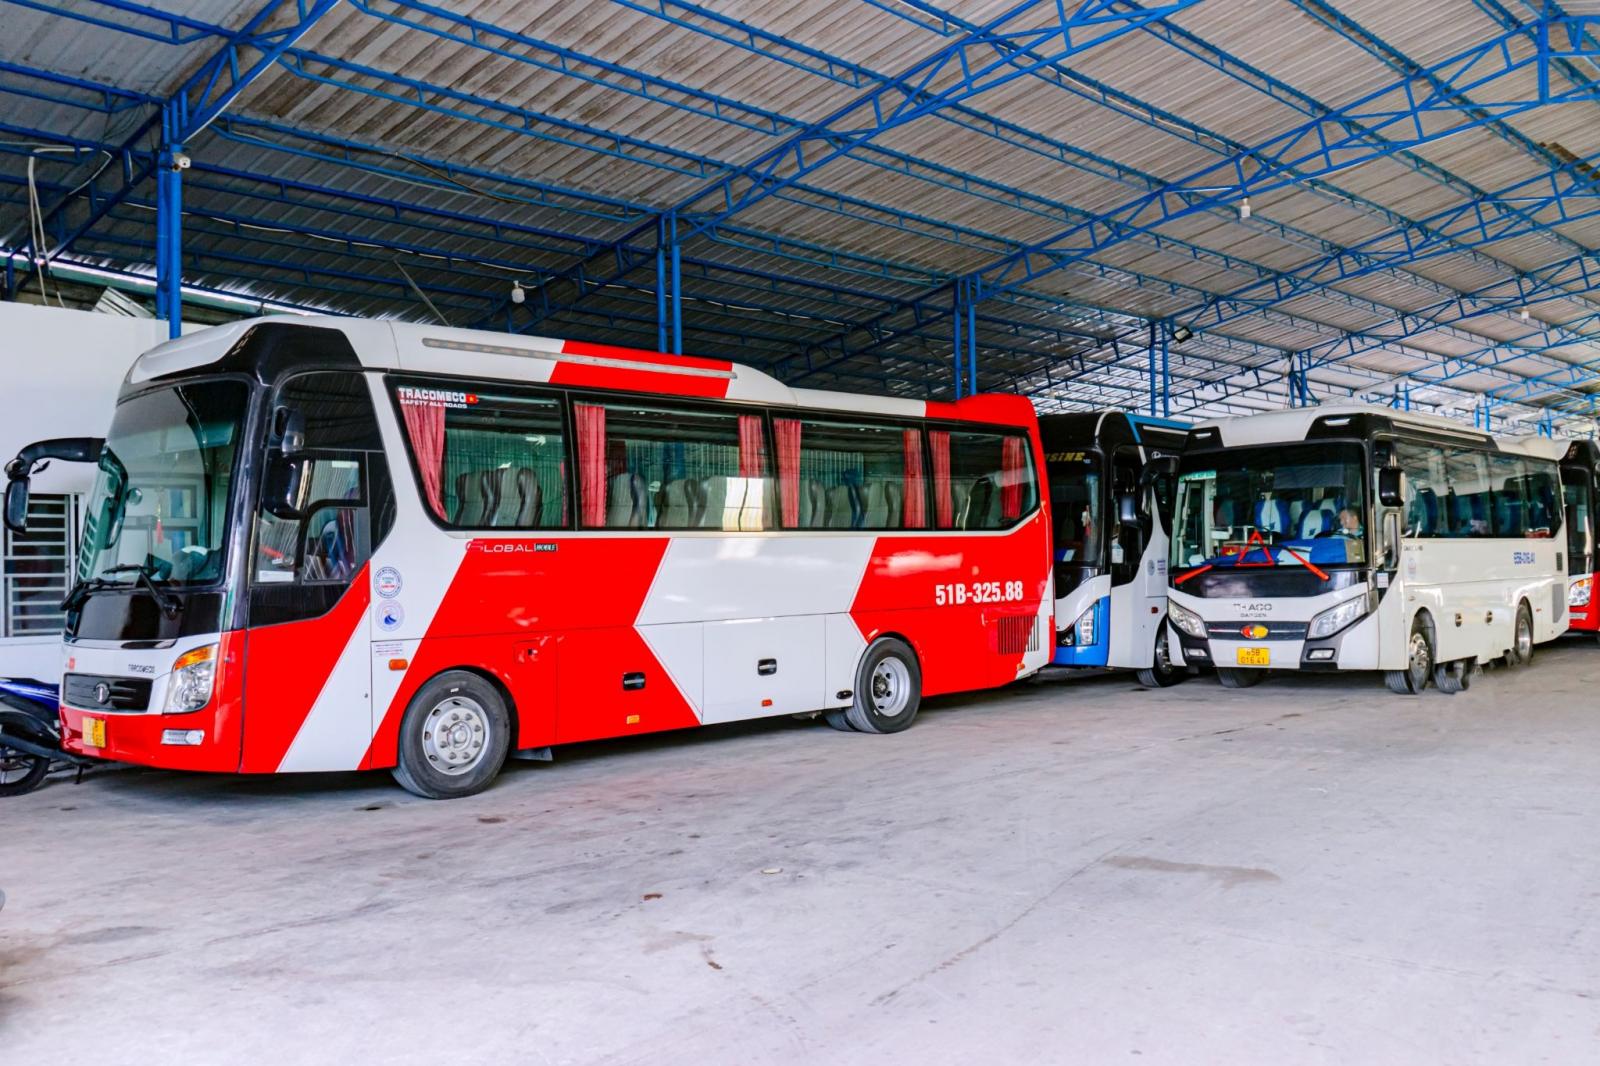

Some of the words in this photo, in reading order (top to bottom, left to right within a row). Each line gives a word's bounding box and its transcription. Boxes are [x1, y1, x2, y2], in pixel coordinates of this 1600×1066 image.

[398, 387, 466, 403] TRACOMECO
[399, 399, 427, 407] SAFETY
[935, 580, 1024, 606] 51B-325.88
